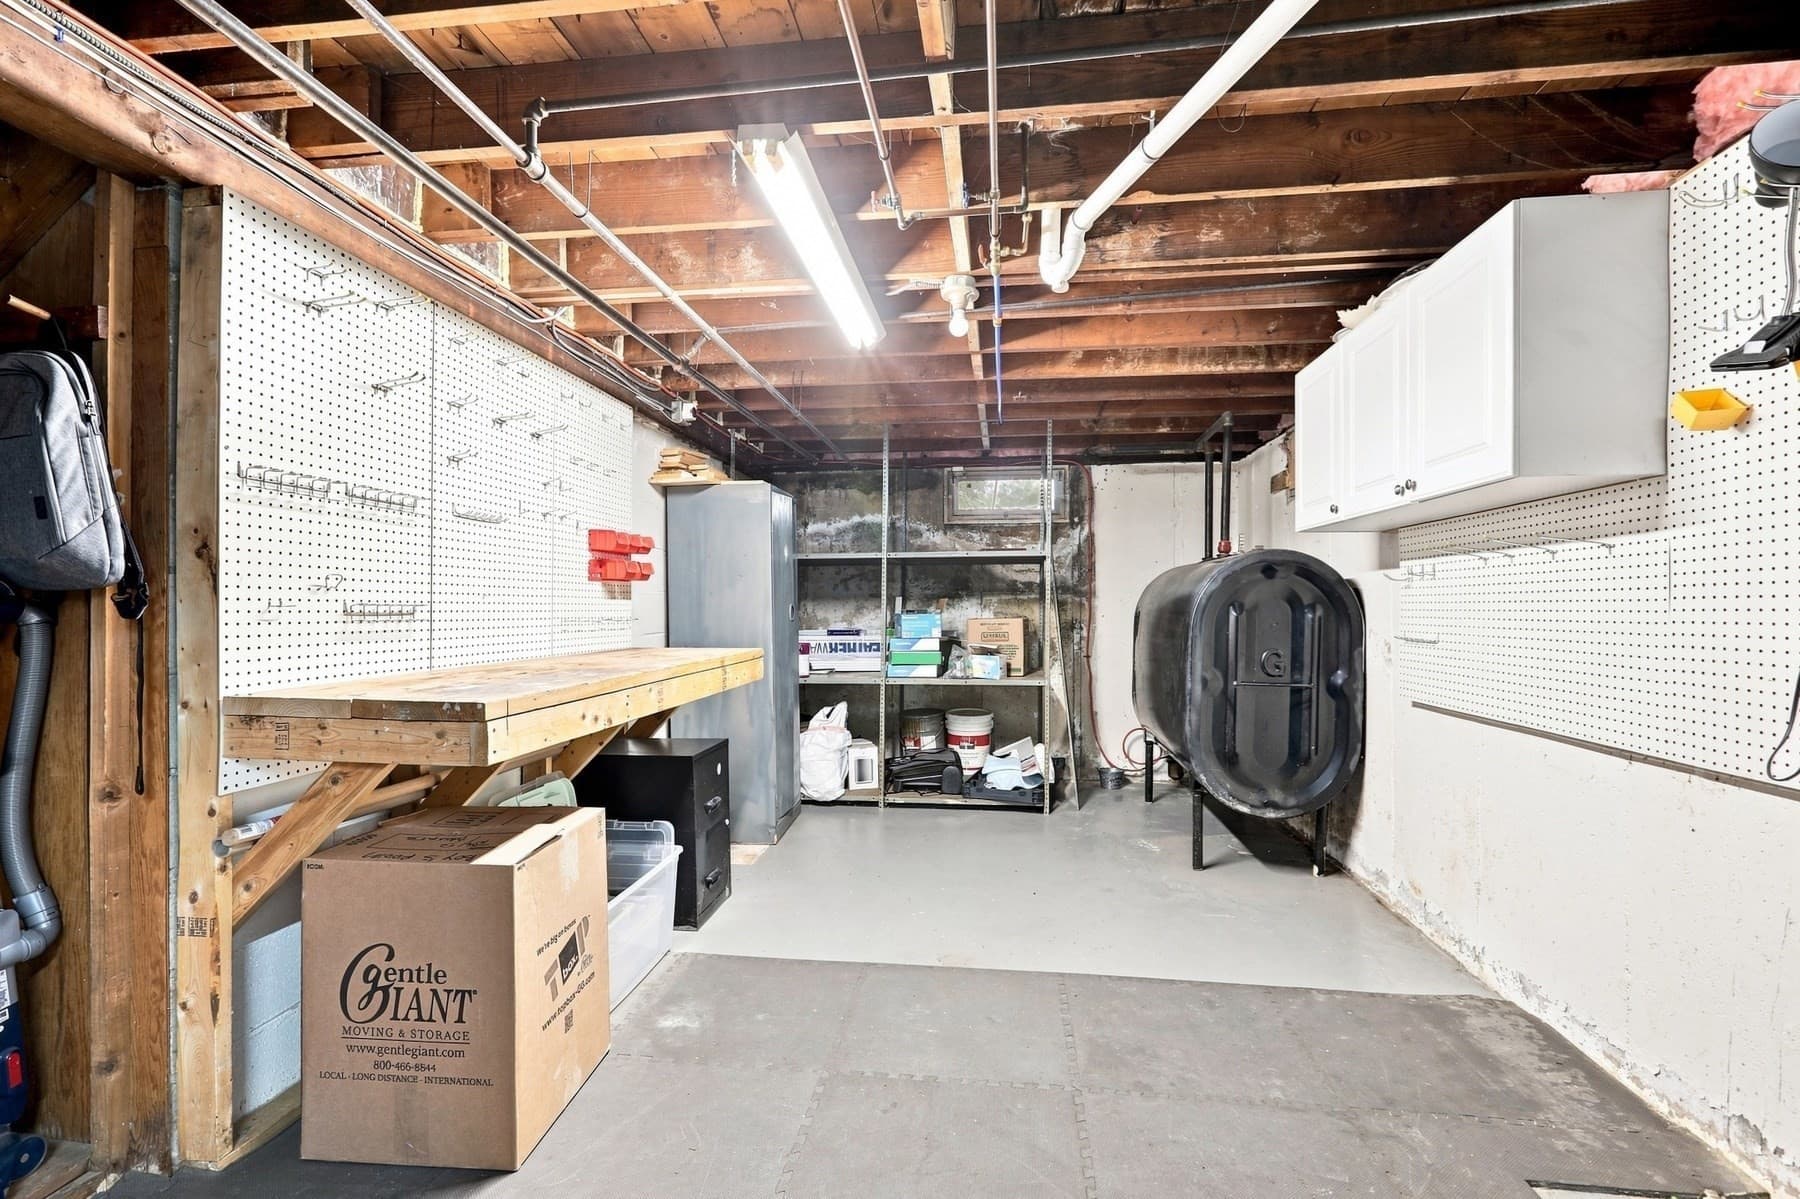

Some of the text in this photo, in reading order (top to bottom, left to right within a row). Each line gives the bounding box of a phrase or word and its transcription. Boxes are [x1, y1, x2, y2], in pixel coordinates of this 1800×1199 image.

[1260, 649, 1286, 678] G
[342, 1026, 471, 1041] MOVING & STORAGE
[346, 1043, 465, 1059] www.gentlegiant.com
[319, 1071, 347, 1080] LOCAL
[352, 1073, 376, 1081] LONG
[377, 1074, 418, 1083] DISTANCE
[424, 1076, 494, 1087] INTERNATIONAL
